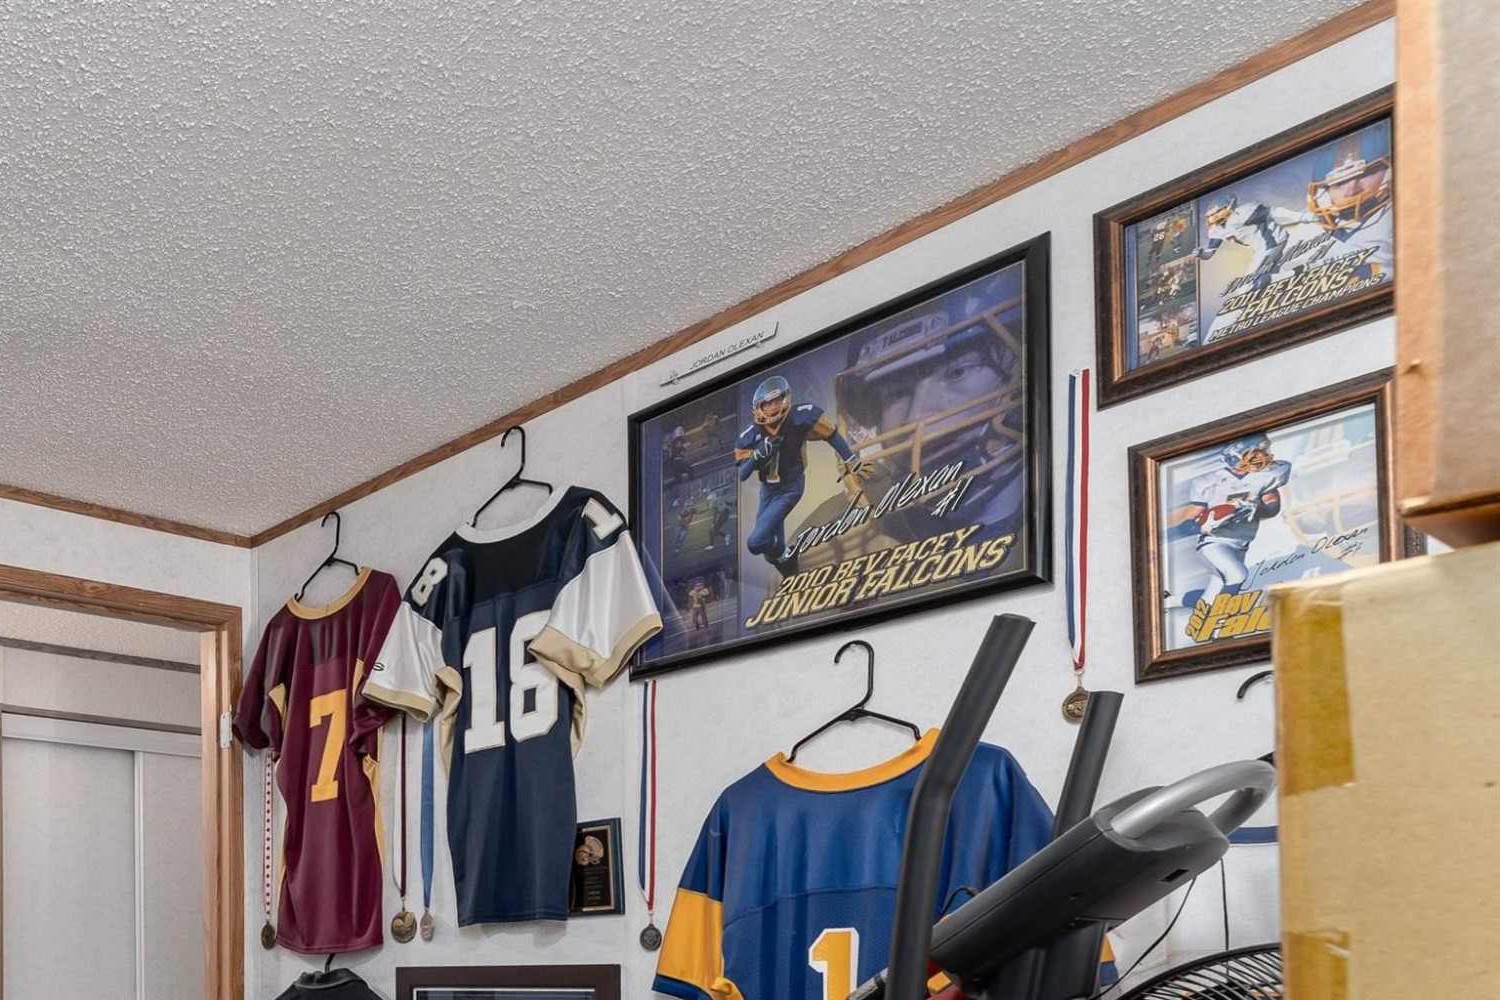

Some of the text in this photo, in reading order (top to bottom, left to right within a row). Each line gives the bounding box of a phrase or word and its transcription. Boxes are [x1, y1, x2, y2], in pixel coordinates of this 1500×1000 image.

[1209, 273, 1384, 342] METRO LEAGUE CHAMPIONS
[1237, 267, 1355, 322] FALCONS
[745, 534, 1016, 629] JUNIOR FALCONS
[775, 566, 830, 597] 2010
[888, 524, 980, 567] FACEY
[309, 688, 347, 803] 7
